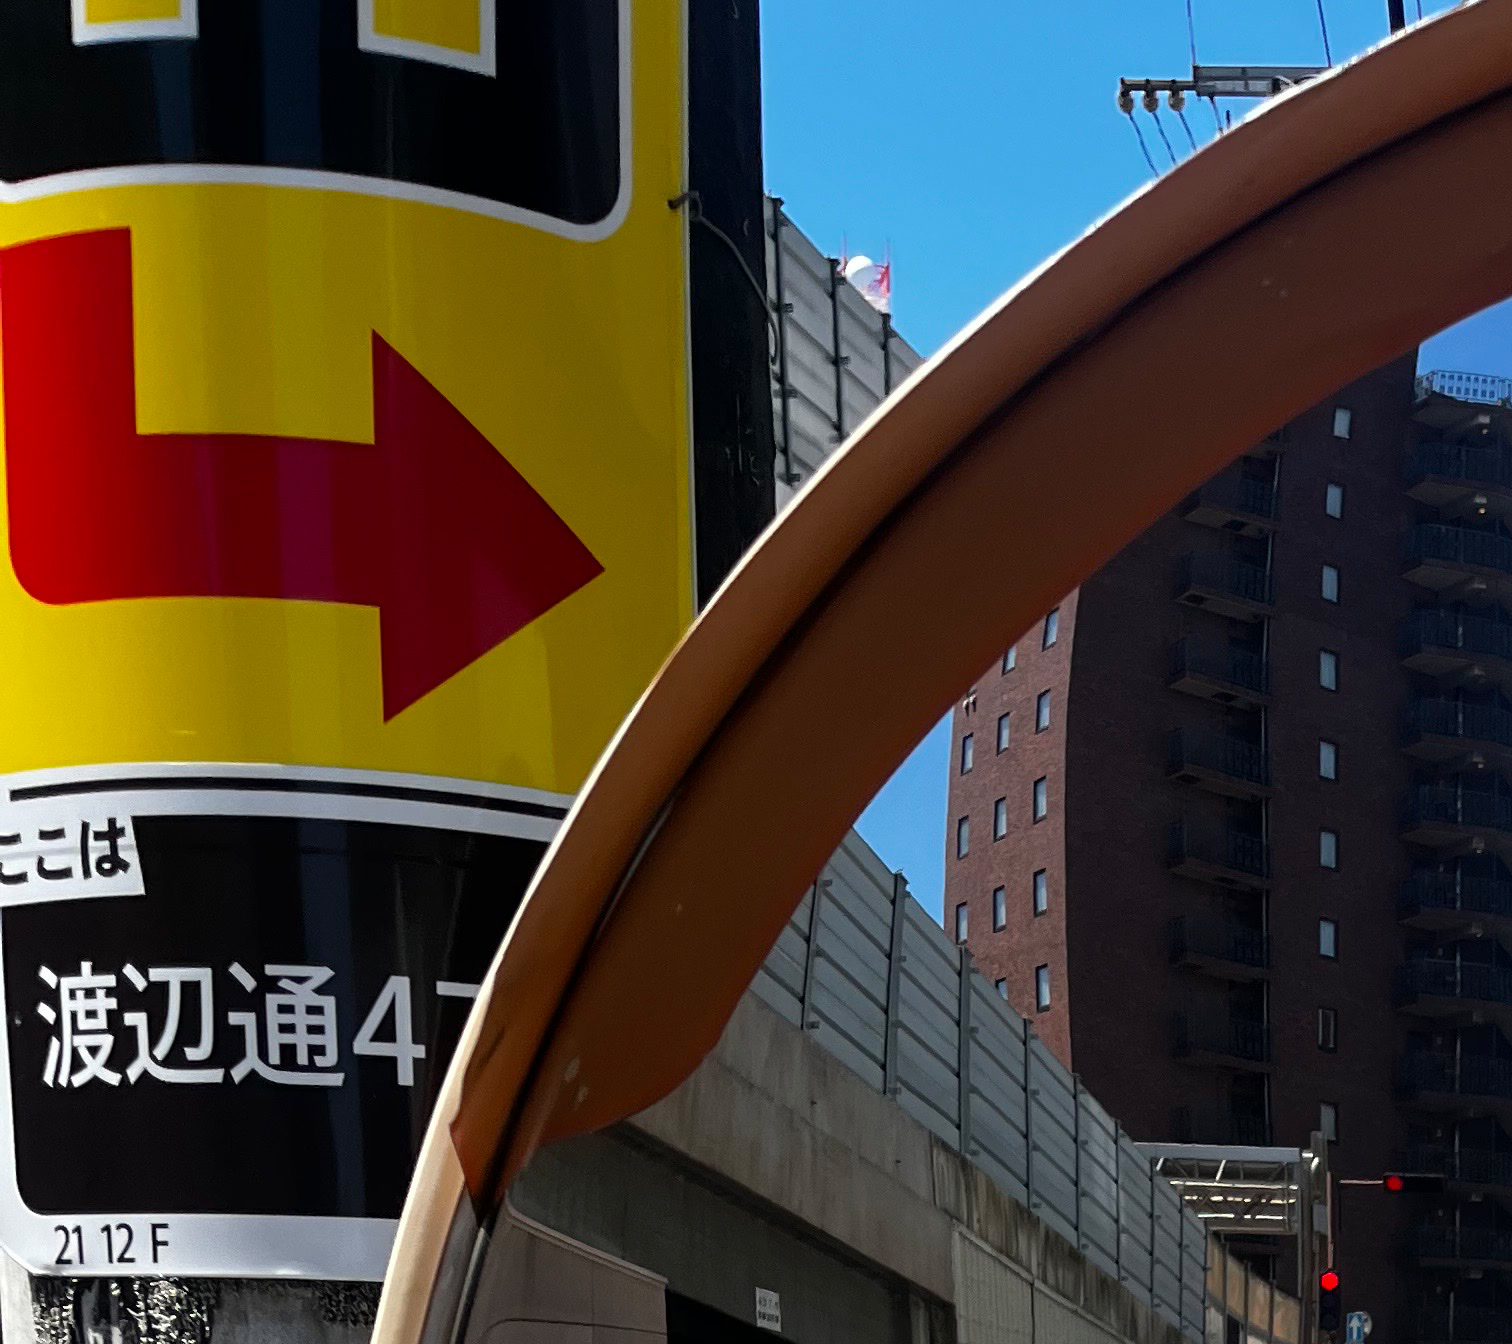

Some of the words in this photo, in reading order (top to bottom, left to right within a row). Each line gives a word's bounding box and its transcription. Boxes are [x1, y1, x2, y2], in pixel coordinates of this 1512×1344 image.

[36, 961, 480, 1088] 渡辺通4
[53, 1225, 85, 1264] 21
[101, 1223, 136, 1263] 12
[151, 1223, 170, 1263] F
